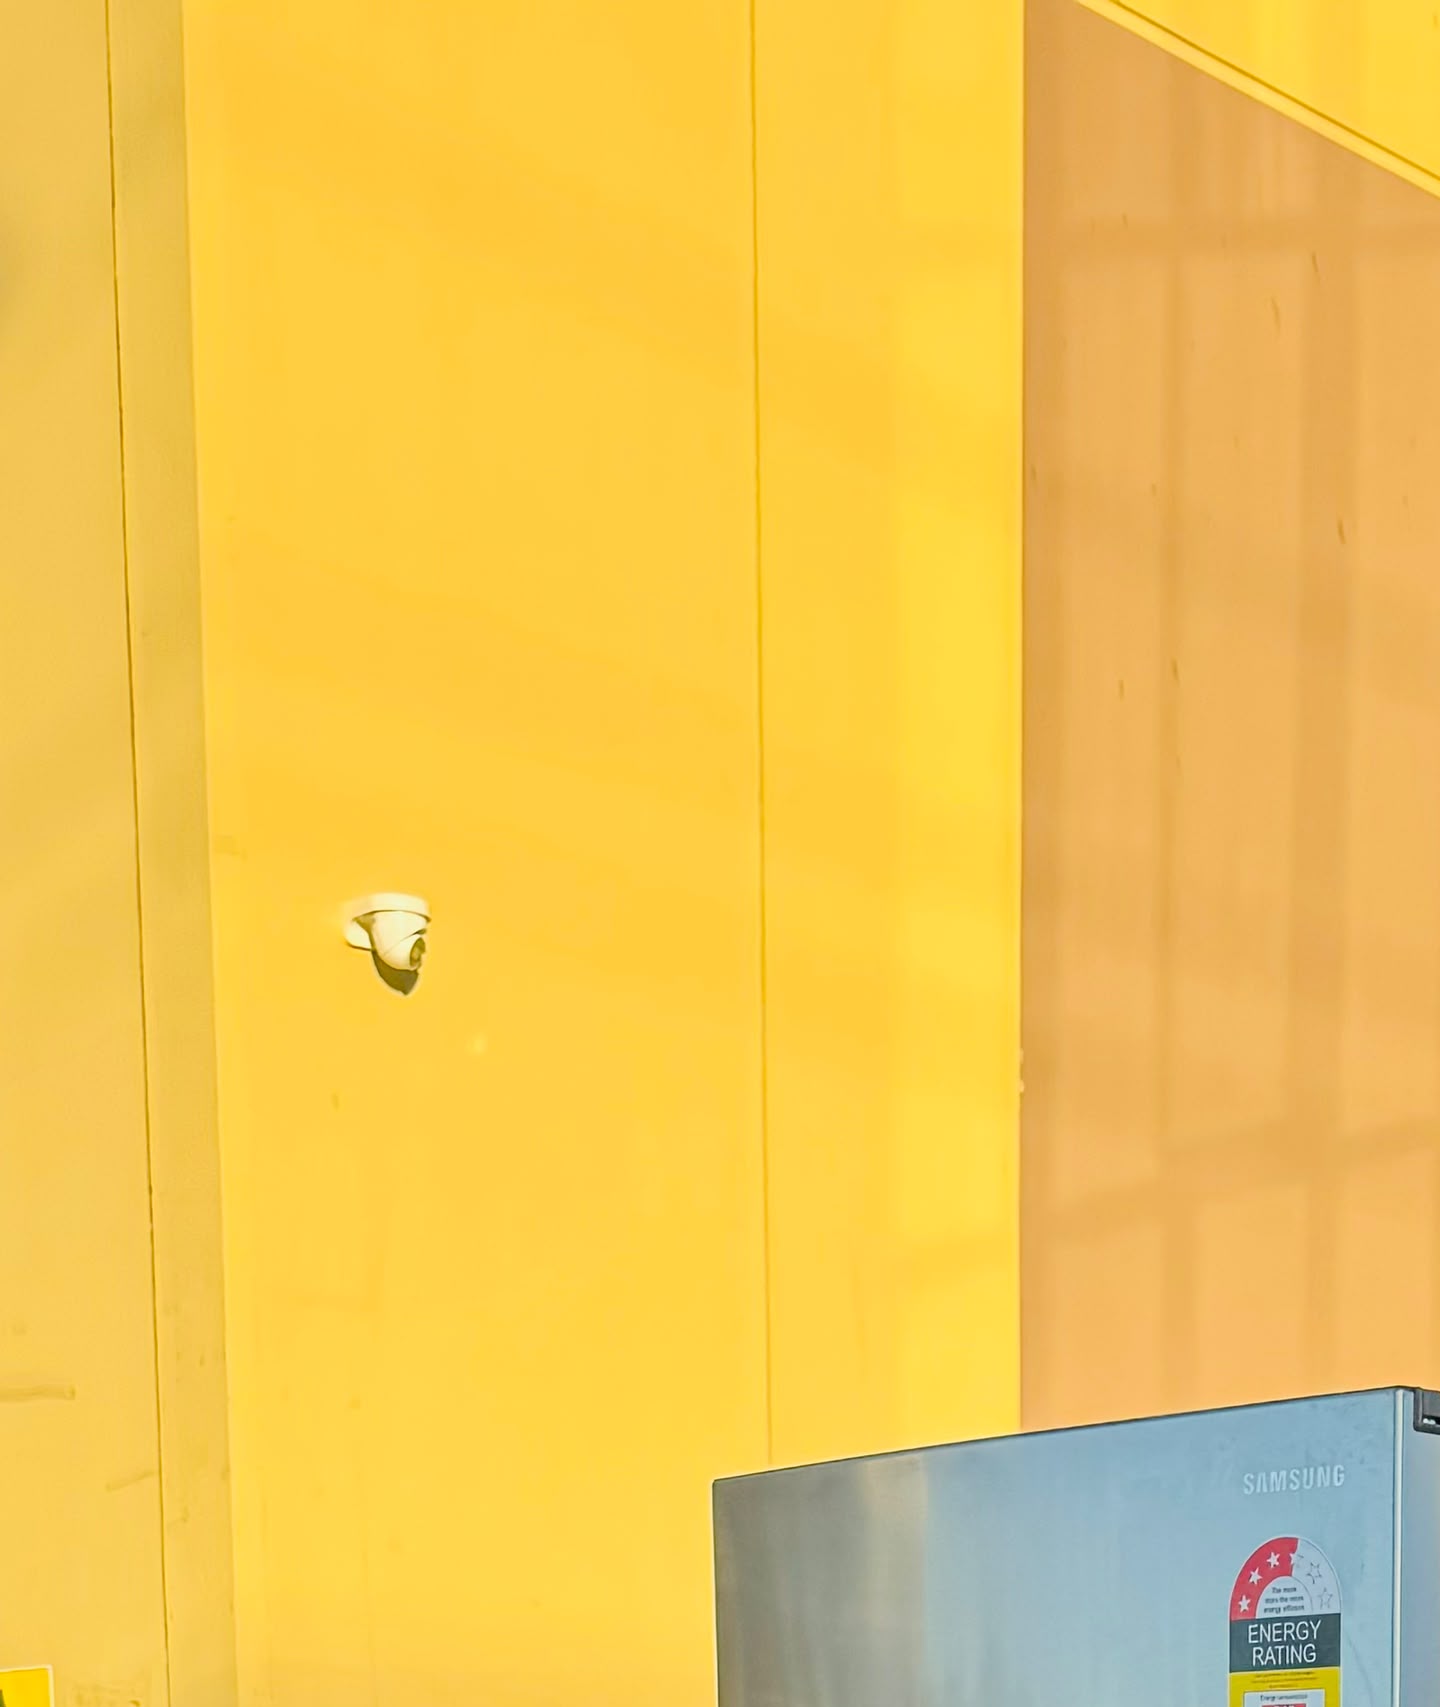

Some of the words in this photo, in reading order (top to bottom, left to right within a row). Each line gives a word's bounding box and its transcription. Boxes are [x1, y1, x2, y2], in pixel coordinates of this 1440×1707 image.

[1243, 1465, 1345, 1495] SAMSUNG
[1248, 1619, 1322, 1644] ENERGY
[1252, 1643, 1317, 1667] RATING
